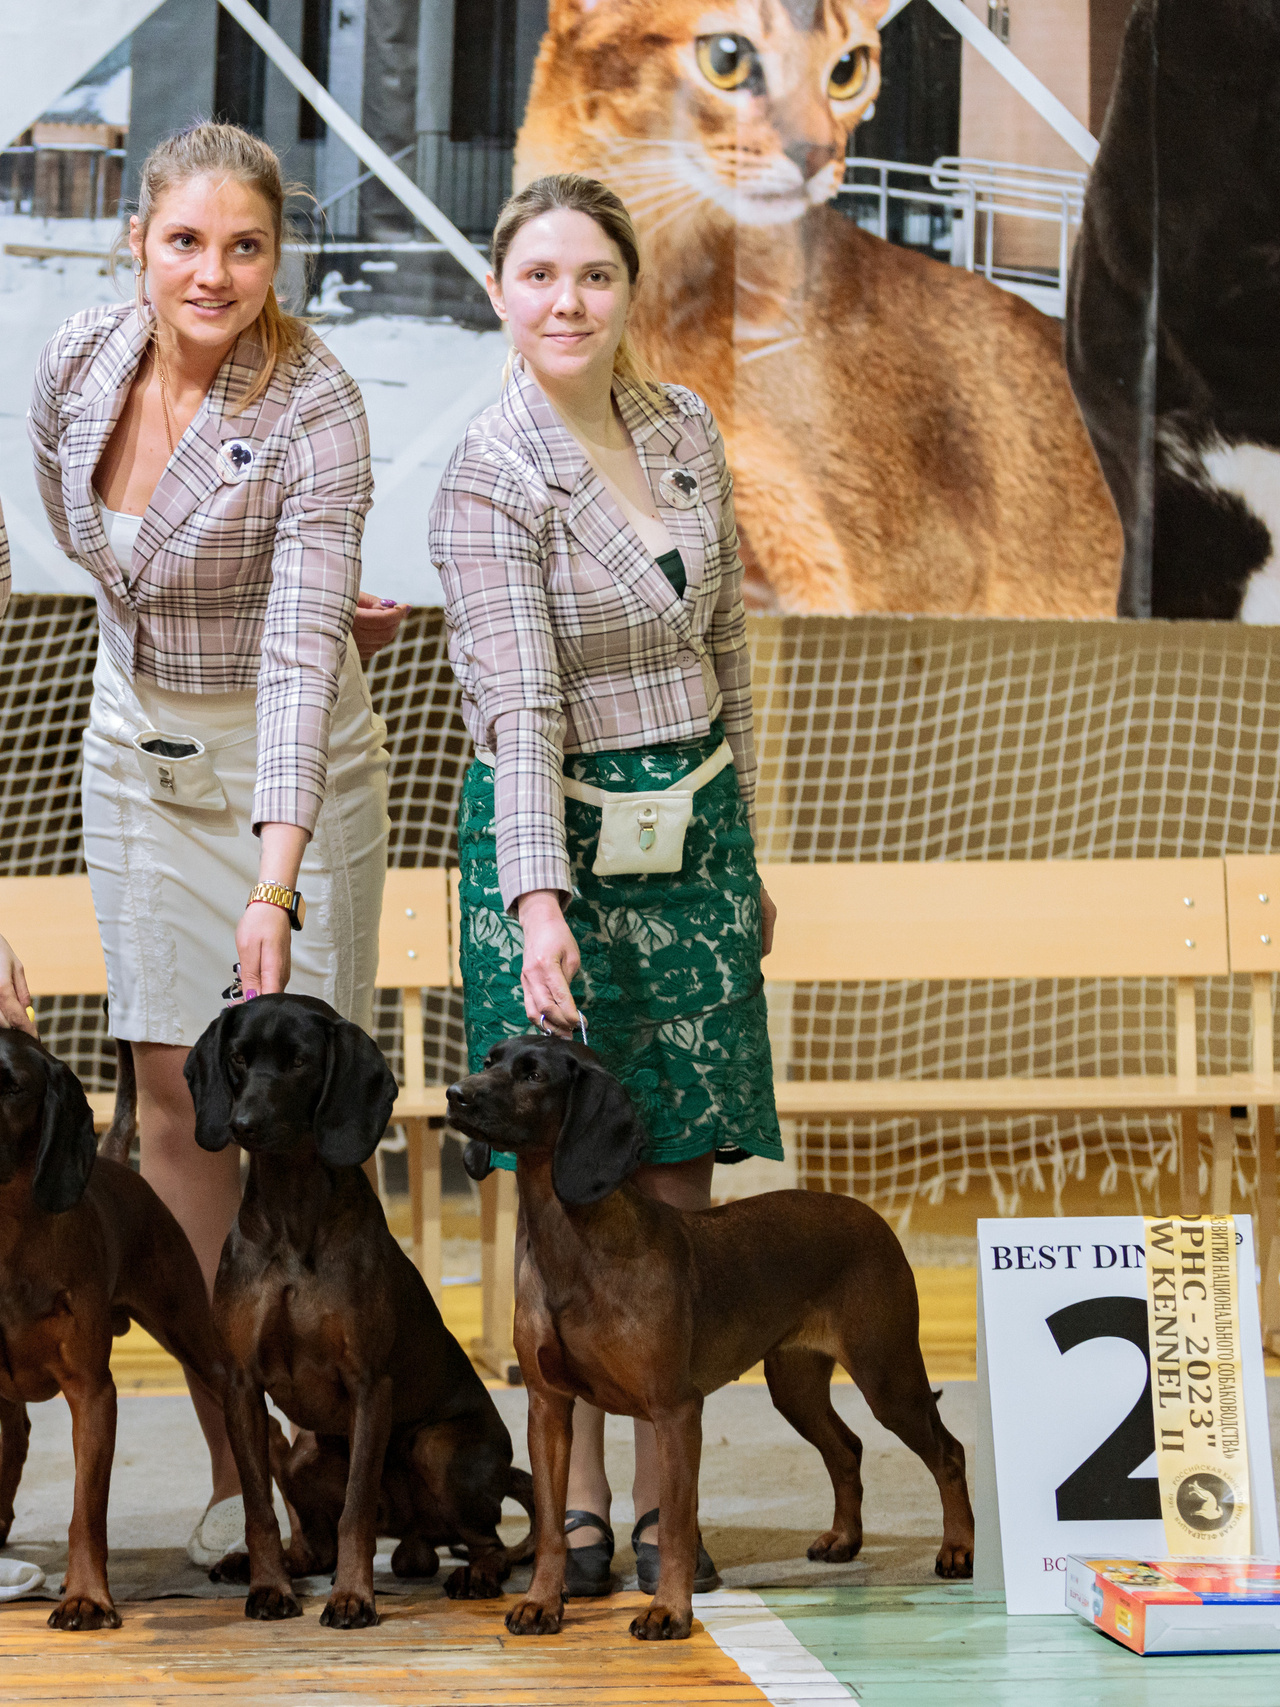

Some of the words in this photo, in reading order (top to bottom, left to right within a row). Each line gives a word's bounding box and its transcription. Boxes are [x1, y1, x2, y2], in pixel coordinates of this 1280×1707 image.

[990, 1244, 1081, 1270] BEST
[1151, 1215, 1174, 1256] W
[1152, 1267, 1182, 1409] KENNEL
[1210, 1265, 1234, 1360] НАЦИОНАЛЬНОГО
[1045, 1296, 1163, 1521] 2
[1161, 1428, 1185, 1453] II
